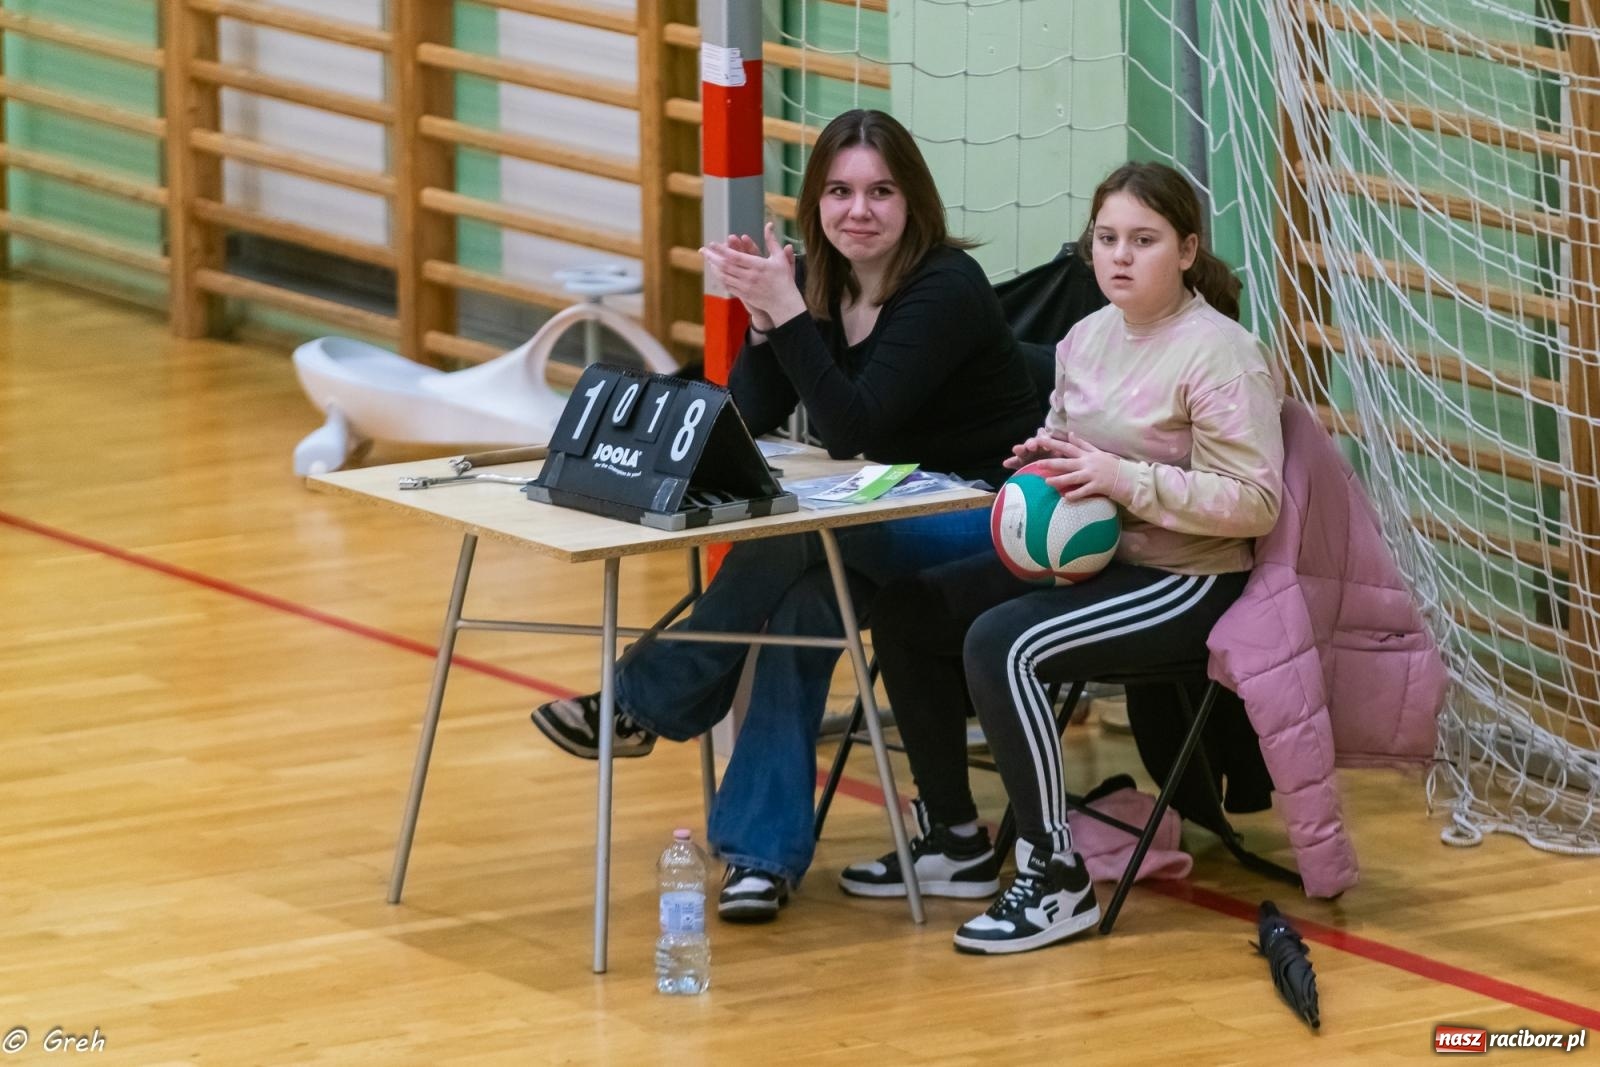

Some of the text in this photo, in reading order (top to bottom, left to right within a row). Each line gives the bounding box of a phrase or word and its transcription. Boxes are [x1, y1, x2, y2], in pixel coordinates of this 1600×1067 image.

[571, 380, 706, 462] 1 0 1 8
[591, 442, 640, 468] JOOLA
